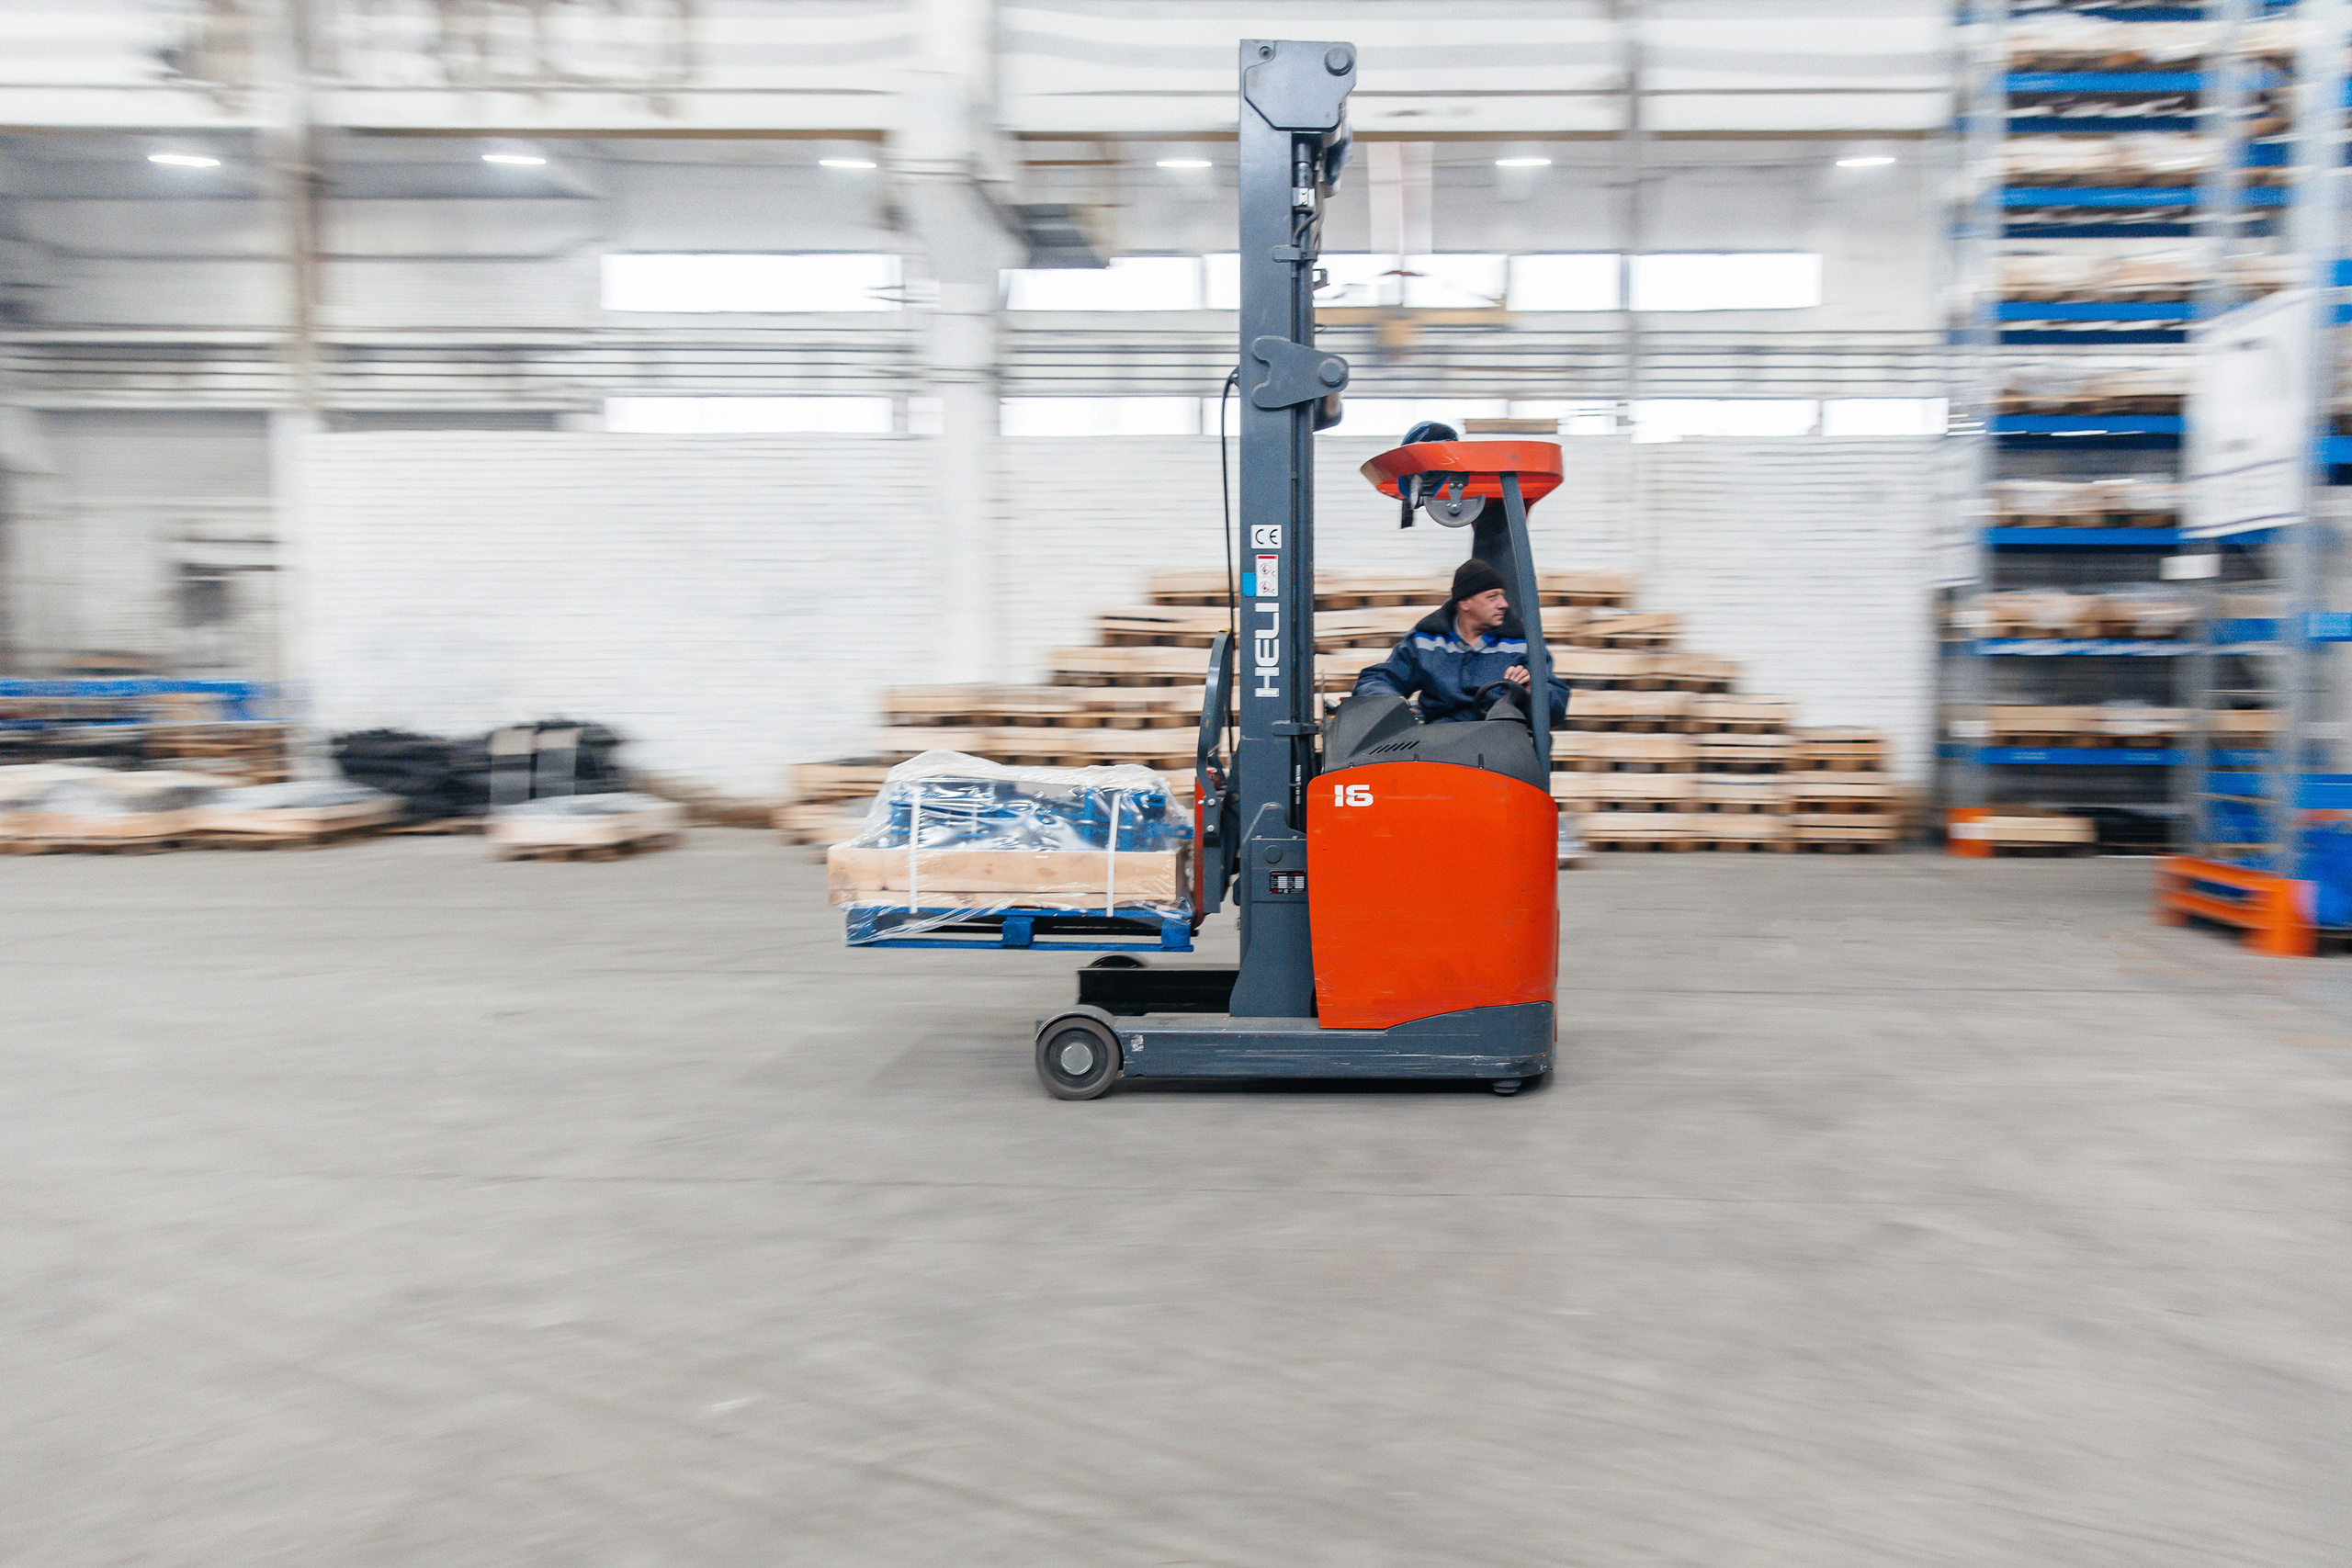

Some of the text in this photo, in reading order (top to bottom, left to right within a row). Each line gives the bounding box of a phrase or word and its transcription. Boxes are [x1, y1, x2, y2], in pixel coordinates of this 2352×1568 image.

[1255, 528, 1278, 545] CE
[1255, 603, 1279, 697] HELI
[1334, 784, 1374, 807] 16
